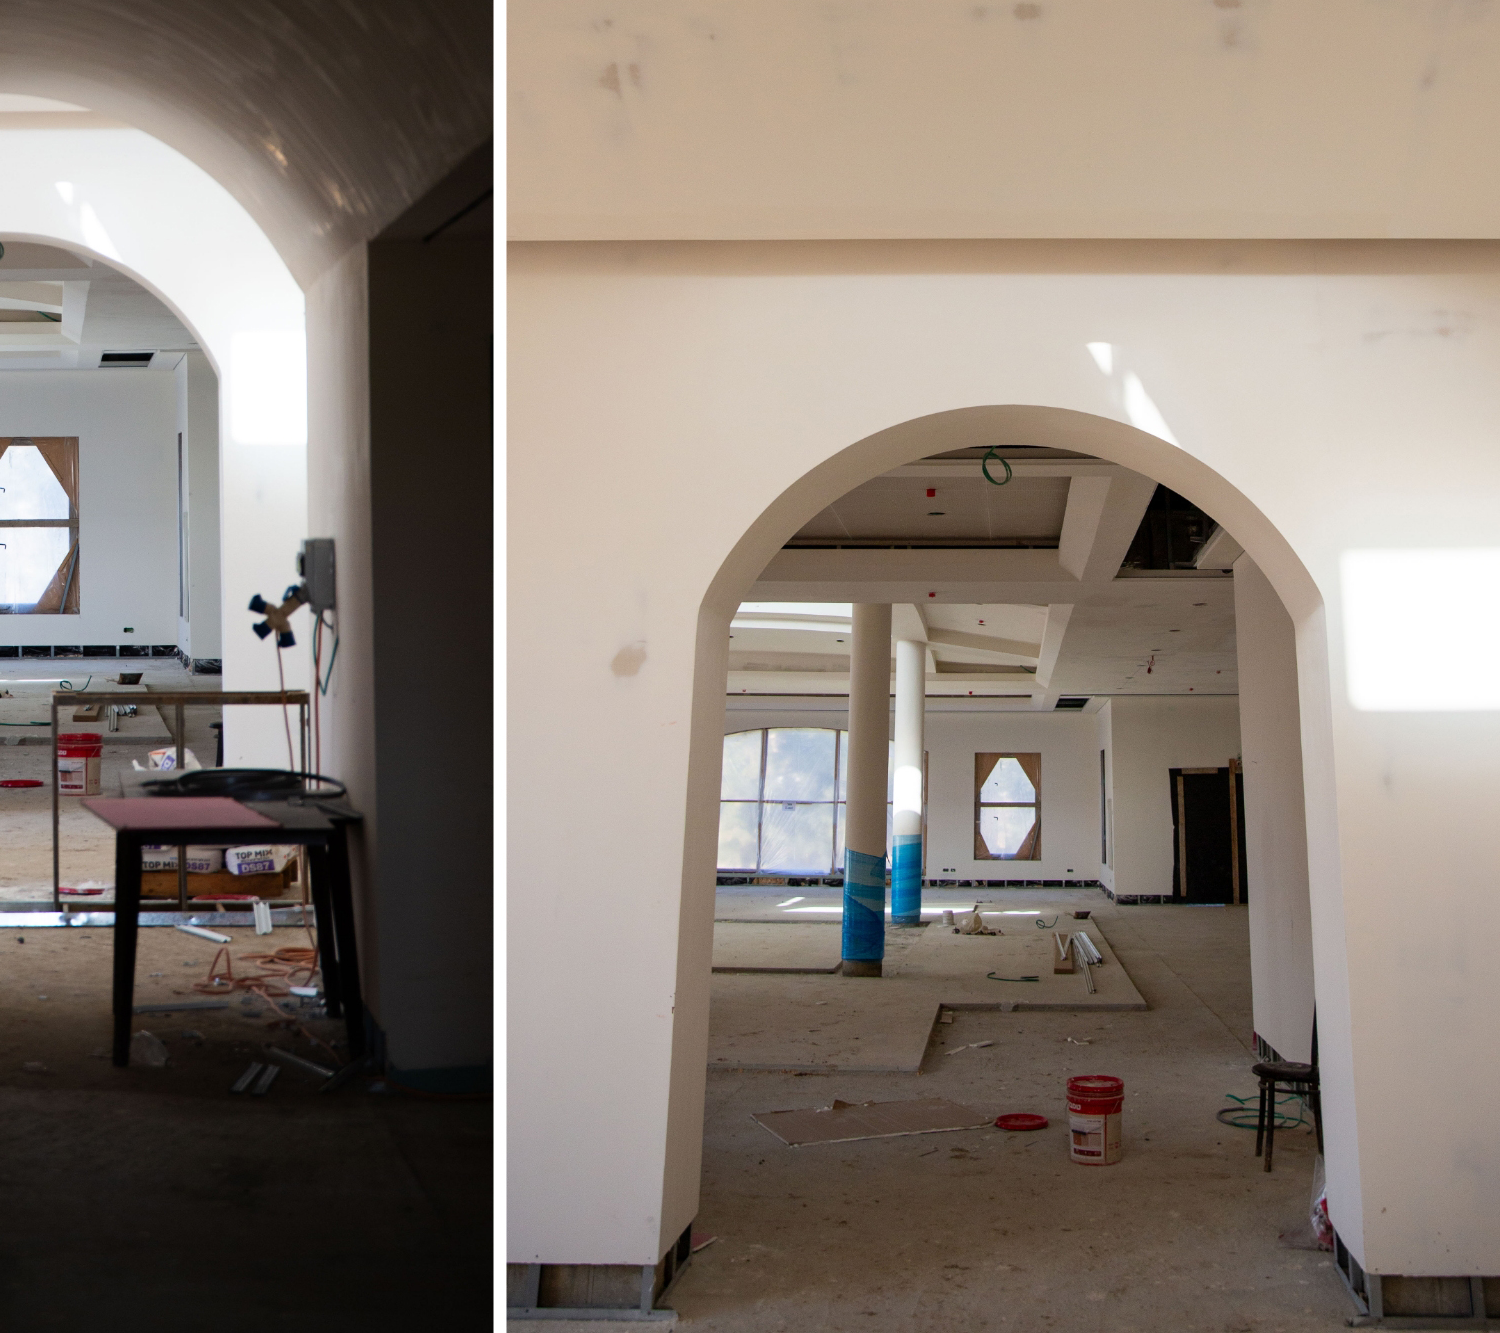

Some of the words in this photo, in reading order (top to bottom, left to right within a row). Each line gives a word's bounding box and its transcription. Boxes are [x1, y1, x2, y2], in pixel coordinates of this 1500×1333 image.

[235, 850, 253, 860] TOP
[254, 848, 273, 859] MIX
[142, 861, 161, 869] TOP
[242, 861, 270, 873] DS87
